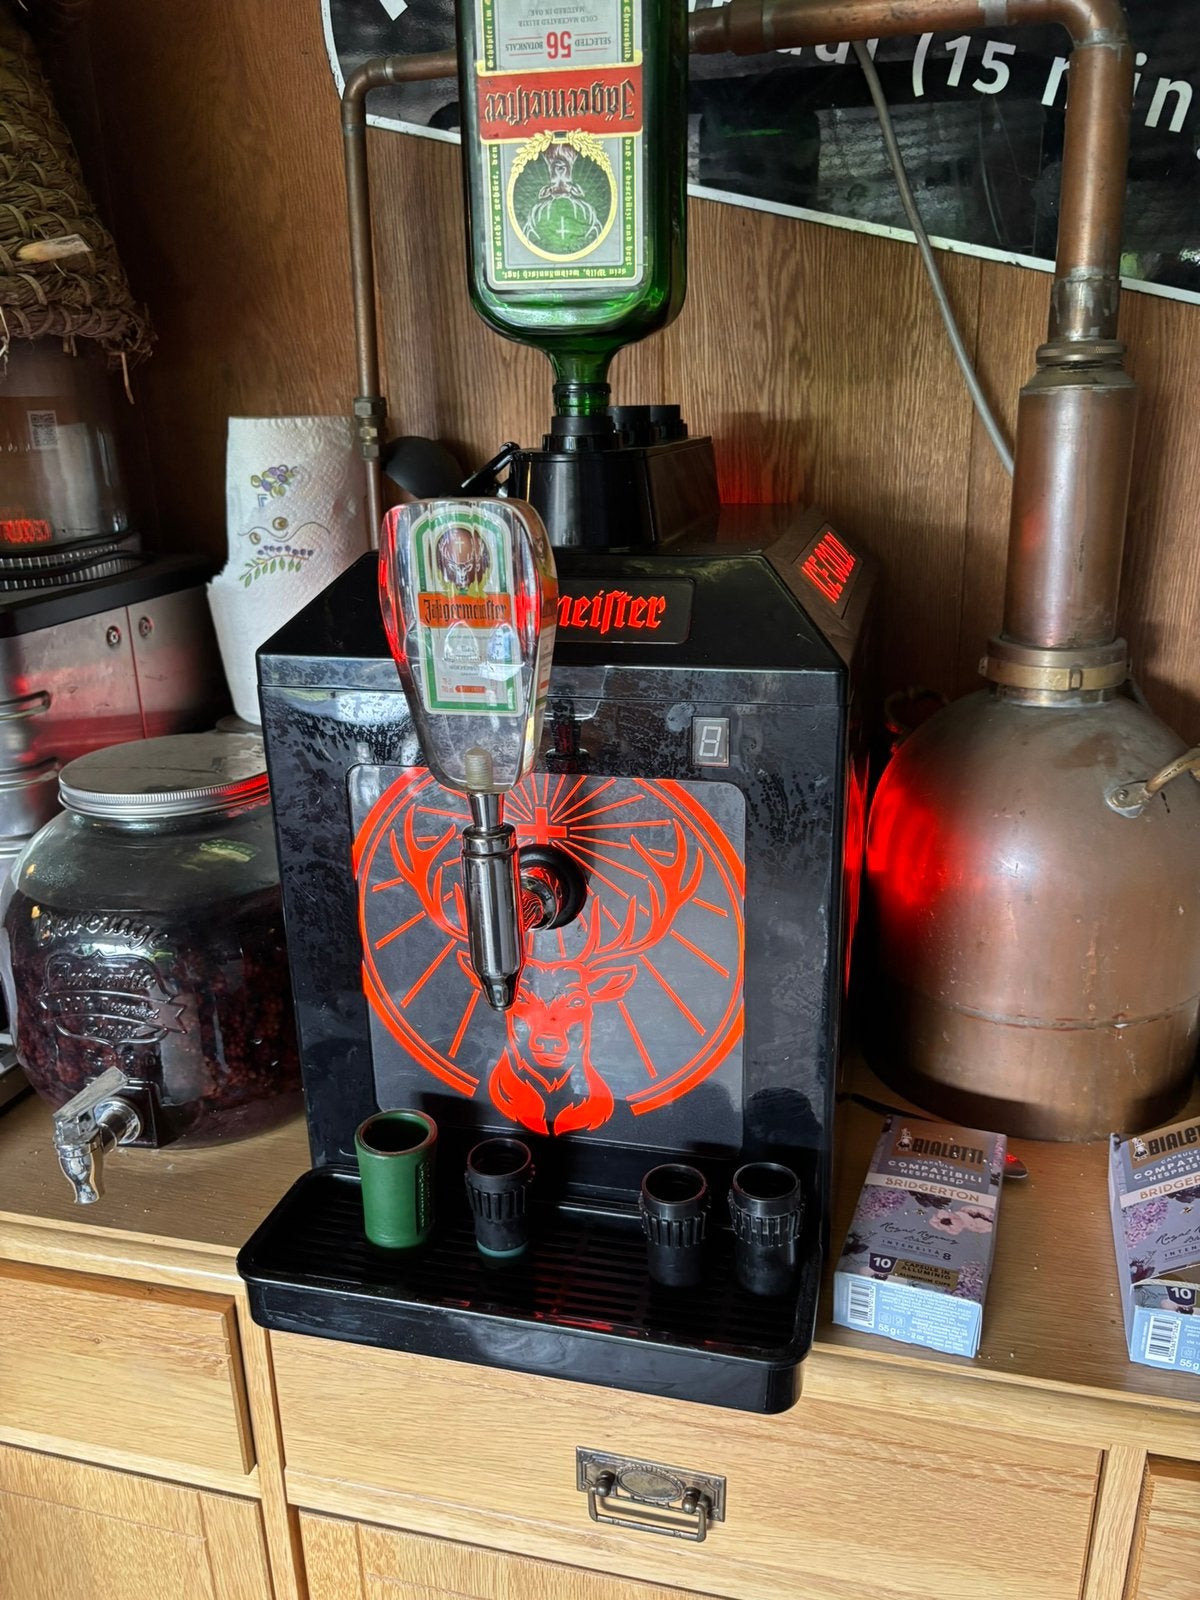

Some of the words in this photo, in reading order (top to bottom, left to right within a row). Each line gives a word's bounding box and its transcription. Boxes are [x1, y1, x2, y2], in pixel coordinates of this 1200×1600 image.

[553, 6, 585, 14] MATURED
[518, 19, 540, 28] ELIXIR
[541, 17, 578, 26] MACERATED
[580, 15, 598, 23] COLD
[505, 41, 544, 52] BOTANICALS
[546, 31, 572, 59] 56
[574, 36, 612, 48] SELECTED
[911, 32, 1017, 98] (15
[801, 554, 843, 605] ICE
[888, 1160, 983, 1184] COMPATIBILI
[885, 1176, 980, 1203] BRIDGERTON
[942, 1252, 952, 1261] 8
[873, 1257, 892, 1269] 10
[904, 1261, 938, 1272] CAPSULE
[901, 1266, 951, 1280] ALLUMINIO
[1170, 1286, 1192, 1300] 10
[878, 1323, 890, 1333] 55
[1179, 1358, 1192, 1368] 55
